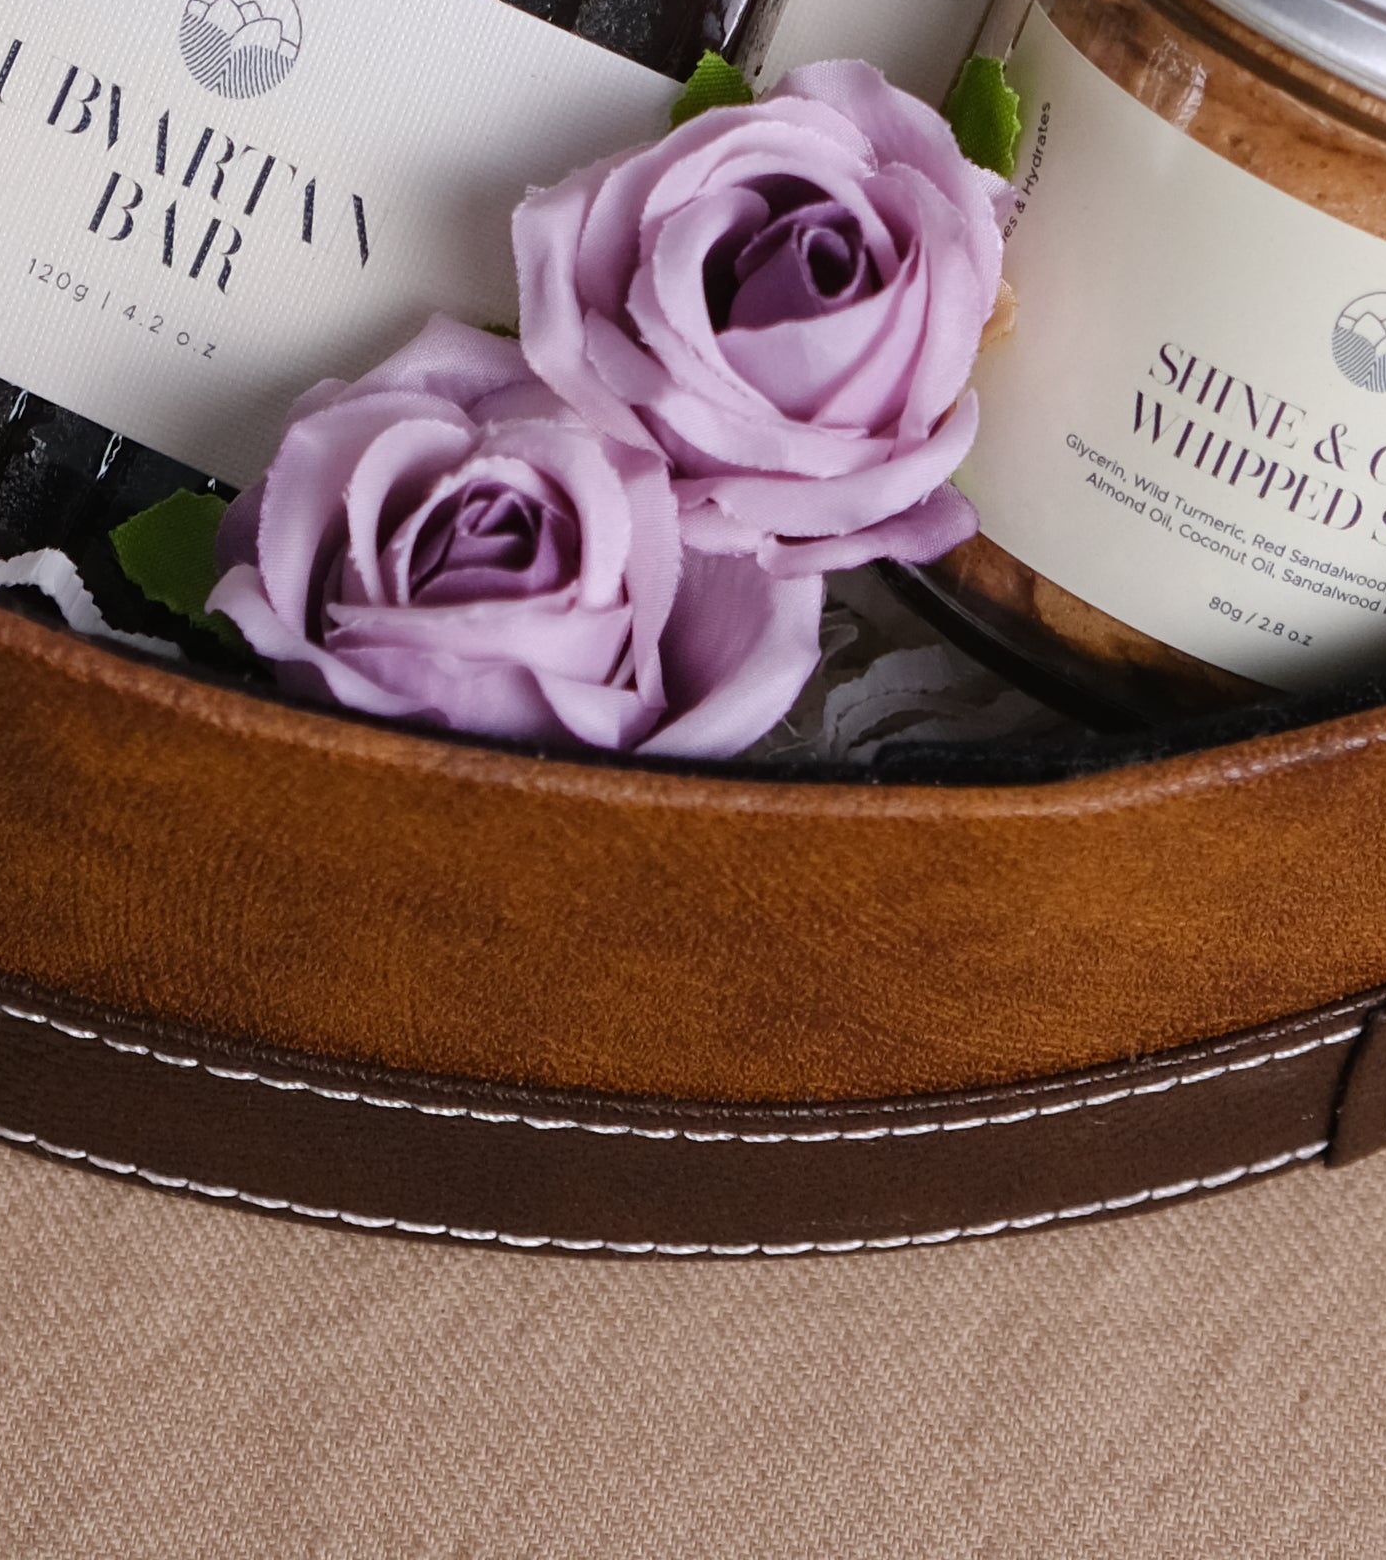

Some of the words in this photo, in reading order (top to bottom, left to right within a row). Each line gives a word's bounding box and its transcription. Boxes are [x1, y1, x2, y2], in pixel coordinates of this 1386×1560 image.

[1021, 100, 1052, 197] Hydrates
[88, 170, 243, 295] BAR
[26, 257, 90, 303] 120g
[122, 304, 165, 335] 4.2
[176, 330, 217, 360] o.z
[1132, 390, 1365, 533] WHIPPED
[1148, 342, 1307, 449] SHINE
[1313, 423, 1357, 472] &
[1065, 432, 1127, 484] Glycerin,
[1133, 473, 1171, 504] Wild
[1174, 495, 1247, 545] Turmeric,
[1251, 532, 1287, 559] Red
[1084, 470, 1147, 516] Almond
[1148, 507, 1174, 533] Oil,
[1178, 522, 1249, 567] Coconut
[1281, 567, 1382, 613] Sandalwood
[1208, 596, 1244, 623] 80g
[1258, 617, 1286, 637] 2.8
[1288, 630, 1314, 648] o.z
